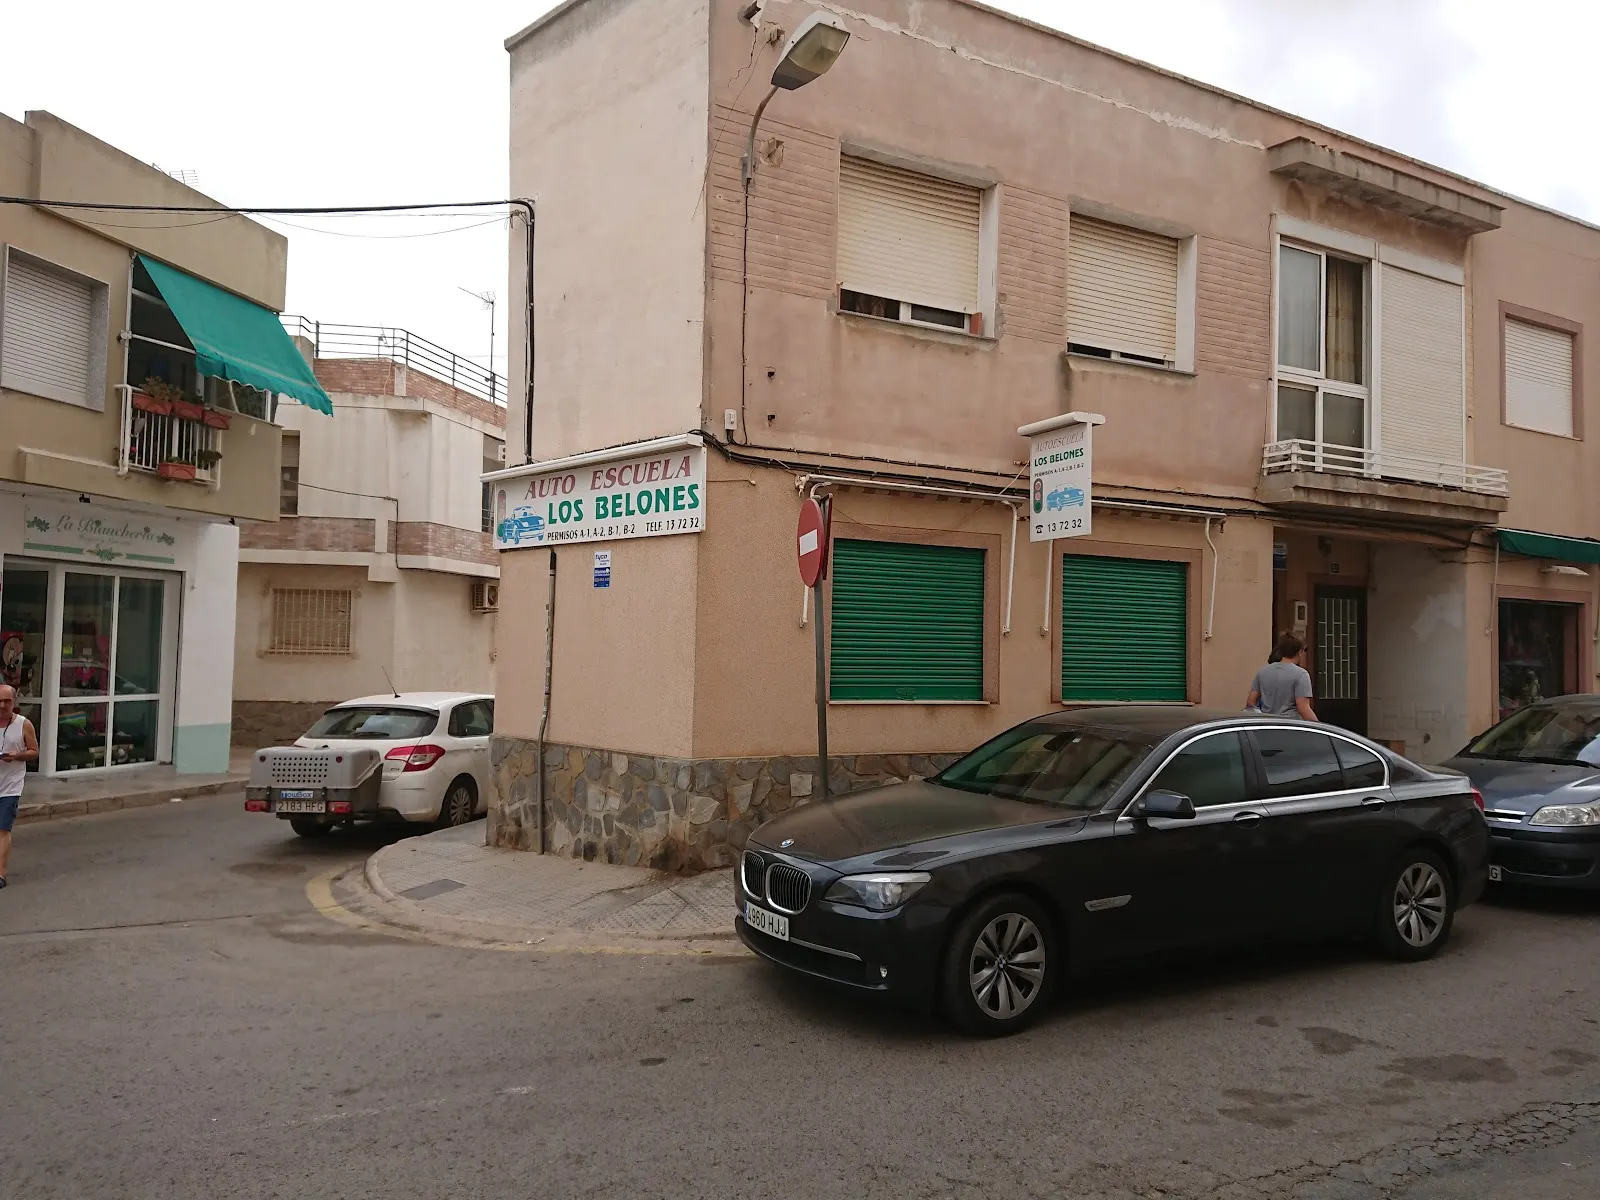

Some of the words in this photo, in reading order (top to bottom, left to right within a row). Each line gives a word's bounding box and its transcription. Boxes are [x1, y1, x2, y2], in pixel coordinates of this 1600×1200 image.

[1036, 432, 1084, 452] AUTOESCUELA
[1034, 456, 1048, 467] LOS
[1049, 447, 1084, 464] BELONES
[524, 474, 576, 500] AUTO
[590, 455, 691, 491] ESCUELA
[548, 499, 584, 524] LOS
[595, 484, 699, 520] BELONES
[51, 514, 73, 533] La
[547, 529, 578, 541] PERMISOS
[666, 519, 675, 531] 13
[677, 518, 687, 530] 72
[689, 517, 699, 529] 32
[1047, 522, 1057, 533] 13
[1059, 520, 1069, 531] 72
[1071, 518, 1082, 529] 32
[278, 801, 302, 811] 2183
[305, 801, 323, 811] HFG
[748, 904, 766, 929] 4960
[768, 915, 786, 937] HJJ
